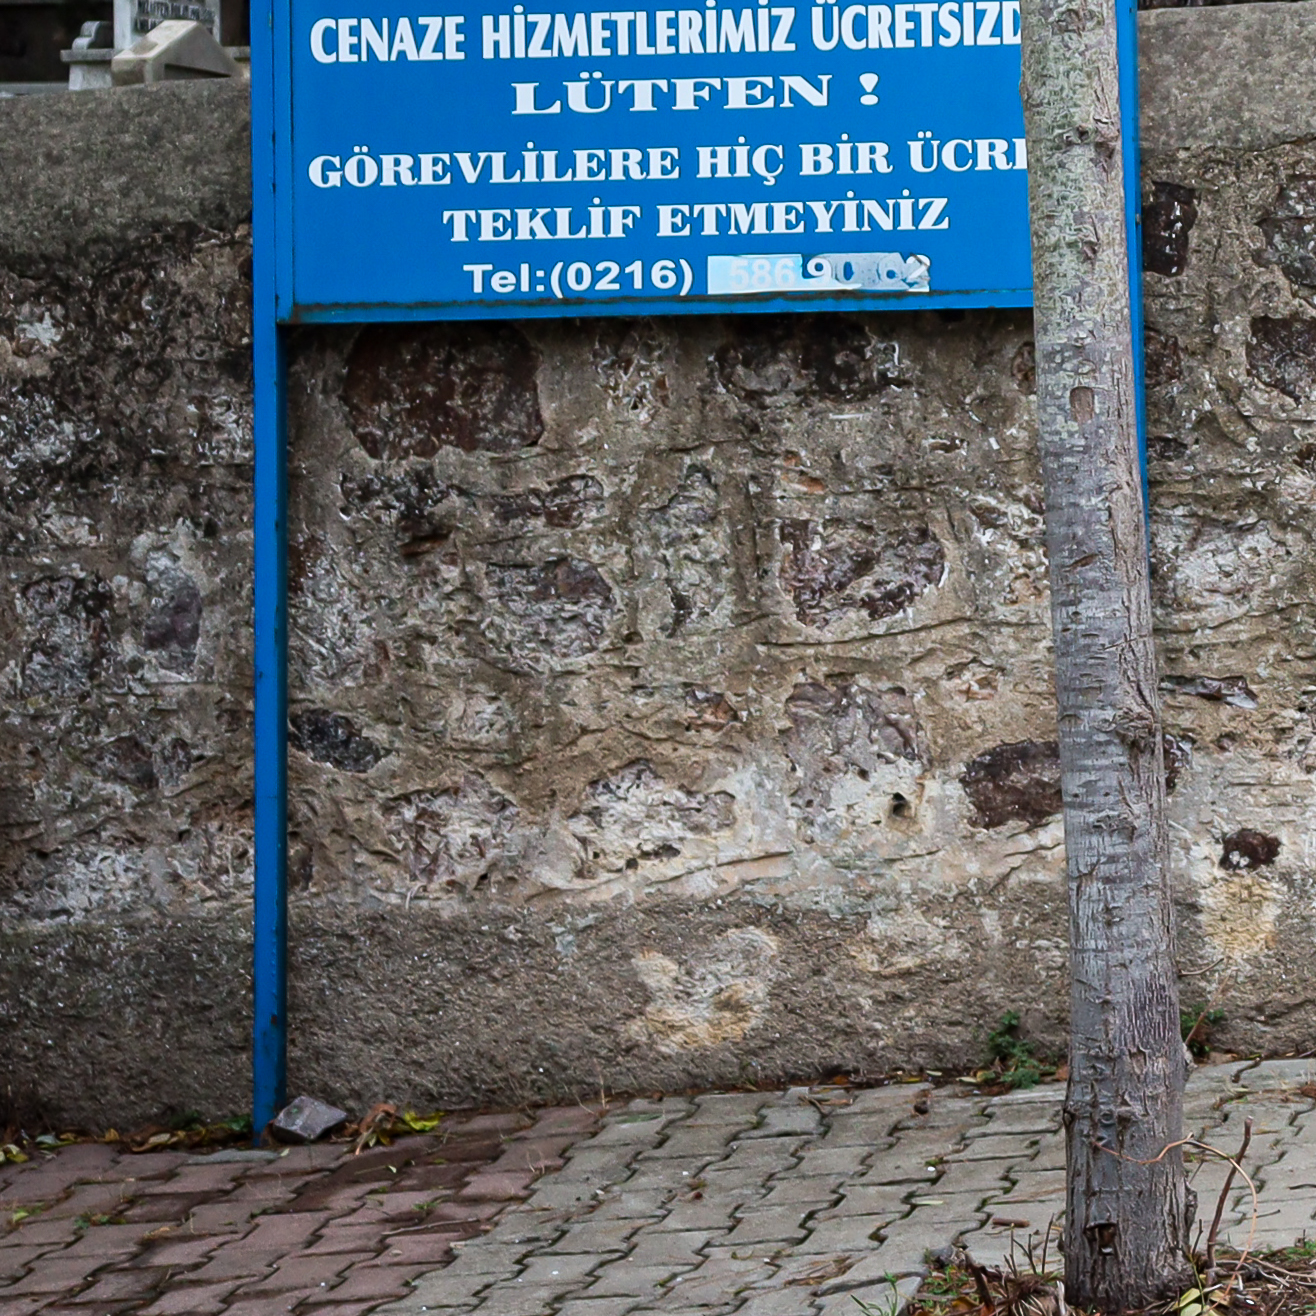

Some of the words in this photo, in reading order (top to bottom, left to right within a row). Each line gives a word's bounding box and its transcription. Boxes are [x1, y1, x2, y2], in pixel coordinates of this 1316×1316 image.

[310, 15, 465, 64] CENAZE
[510, 70, 833, 115] LÜTFEN
[859, 72, 880, 106] !
[308, 141, 680, 188] GÖREVLİLERE
[695, 136, 784, 186] HİÇ
[798, 133, 894, 176] BİR
[442, 197, 641, 242] TEKLİF
[656, 188, 950, 237] ETMEYİNİZ
[462, 258, 693, 299] Tel:(0216)
